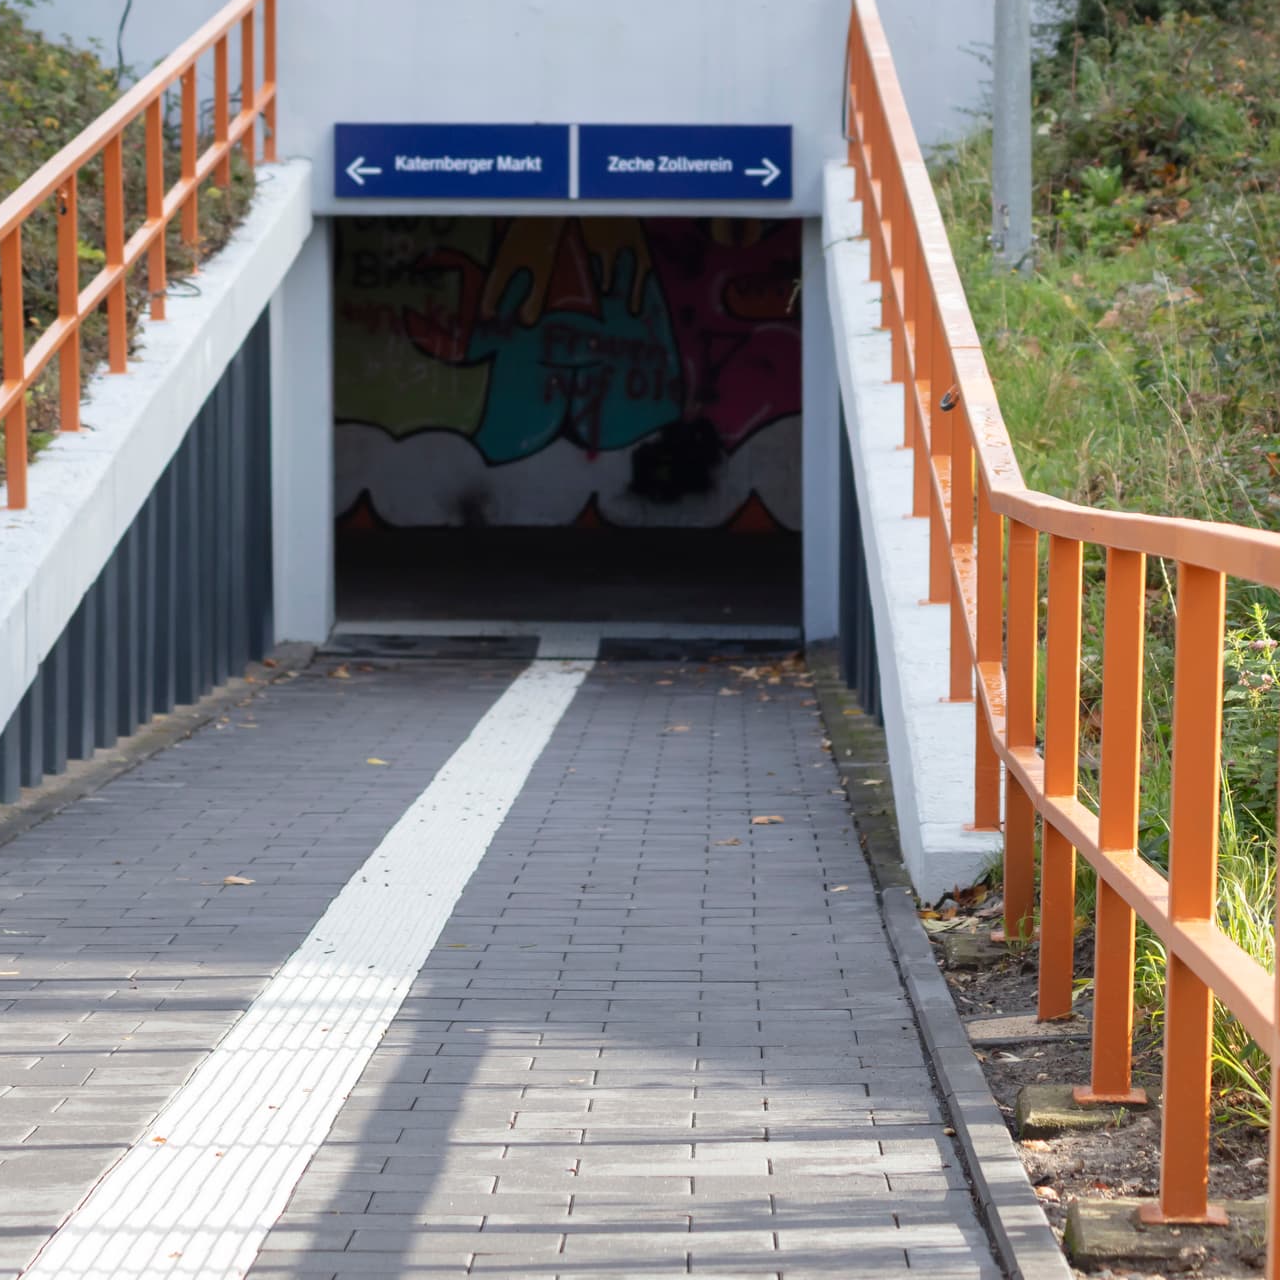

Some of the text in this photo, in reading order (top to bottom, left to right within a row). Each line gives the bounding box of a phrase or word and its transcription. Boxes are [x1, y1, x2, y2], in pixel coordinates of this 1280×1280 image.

[394, 155, 542, 175] Katernberger Markt
[607, 156, 733, 173] Zeche Zollverein
